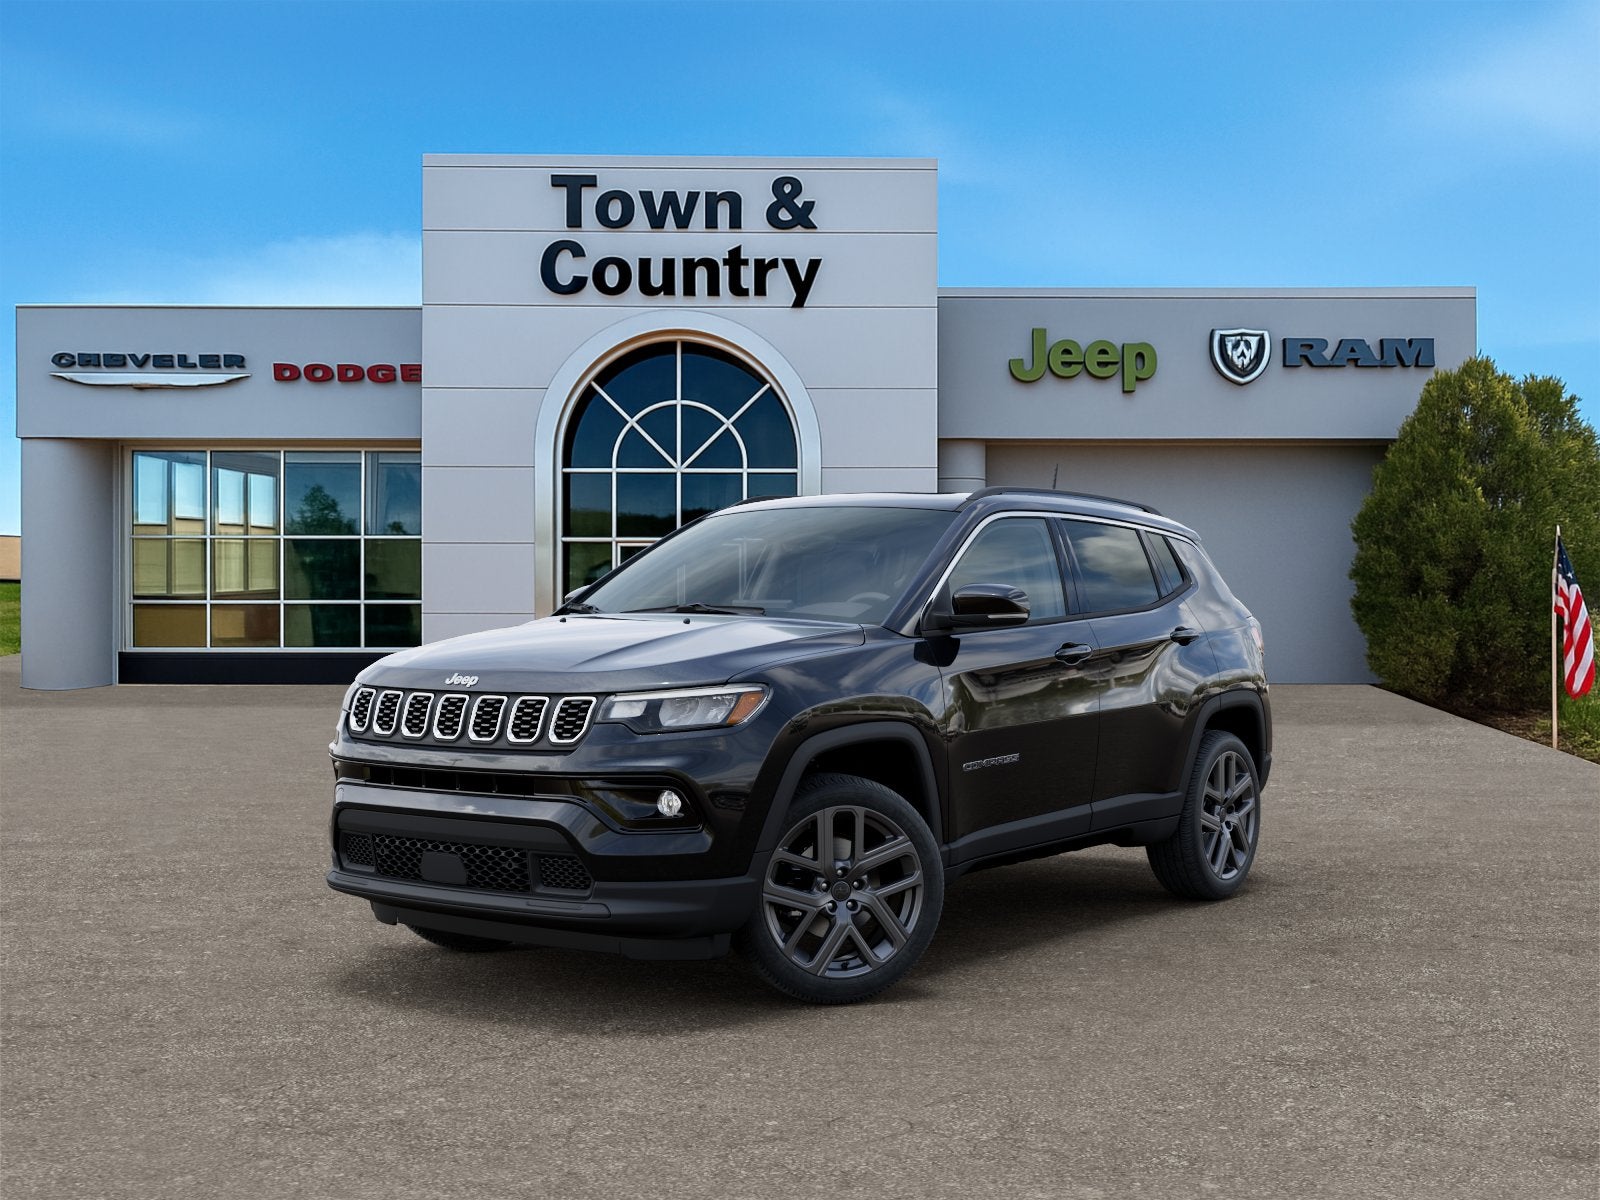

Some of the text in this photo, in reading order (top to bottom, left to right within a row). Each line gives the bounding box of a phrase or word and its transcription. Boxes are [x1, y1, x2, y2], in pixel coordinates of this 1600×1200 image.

[551, 174, 818, 230] Town &
[540, 239, 823, 309] Country
[272, 363, 422, 384] DODGE
[1009, 328, 1157, 393] Jeep
[1282, 337, 1435, 368] RAM
[445, 672, 480, 688] Jeep
